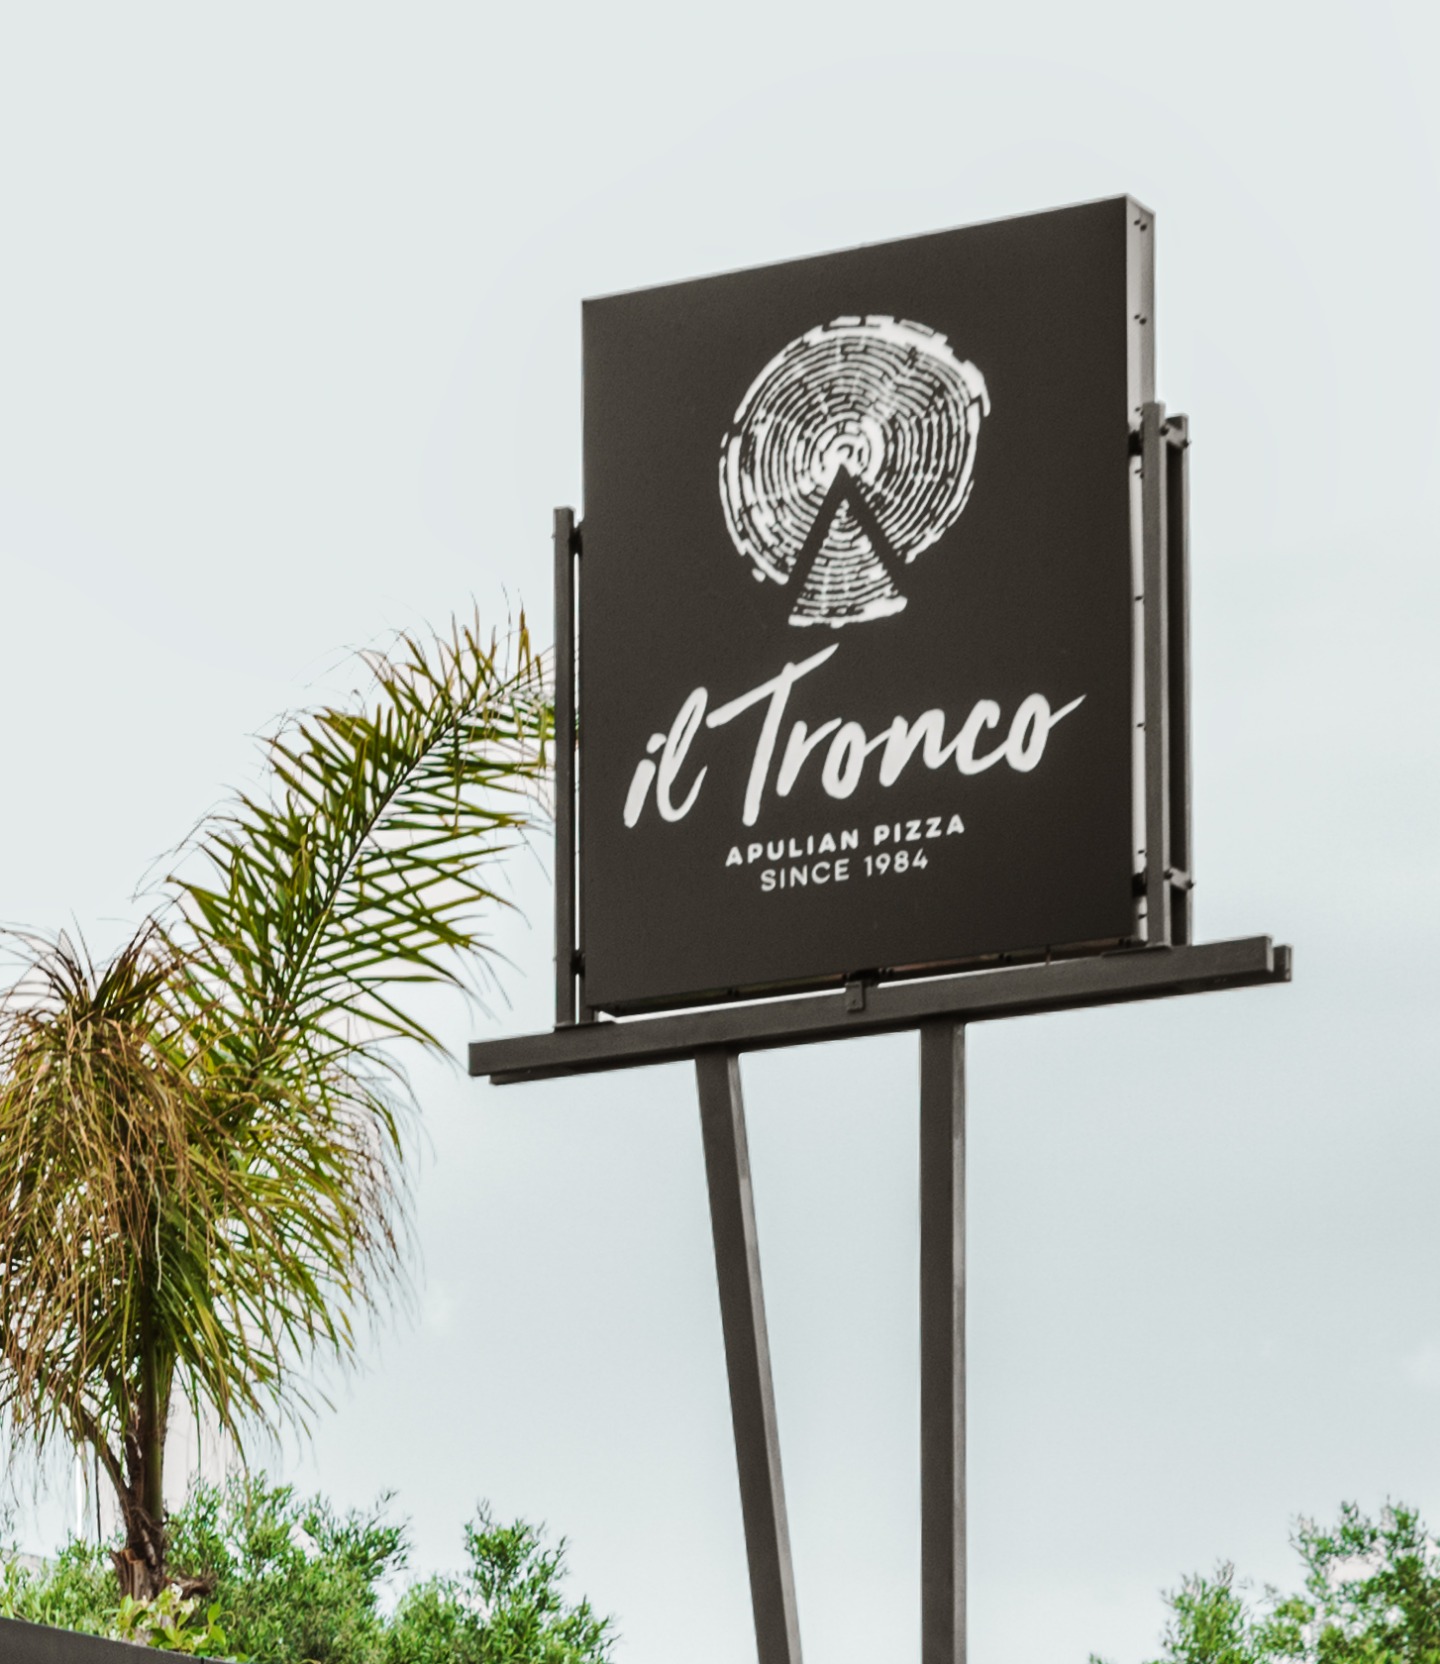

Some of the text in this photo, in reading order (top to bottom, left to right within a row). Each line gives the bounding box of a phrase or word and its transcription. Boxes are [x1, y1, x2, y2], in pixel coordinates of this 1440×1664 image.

[623, 643, 1086, 829] il Tronco
[725, 814, 965, 868] APULIAN PIZZA
[760, 848, 929, 892] SINCE 1984
